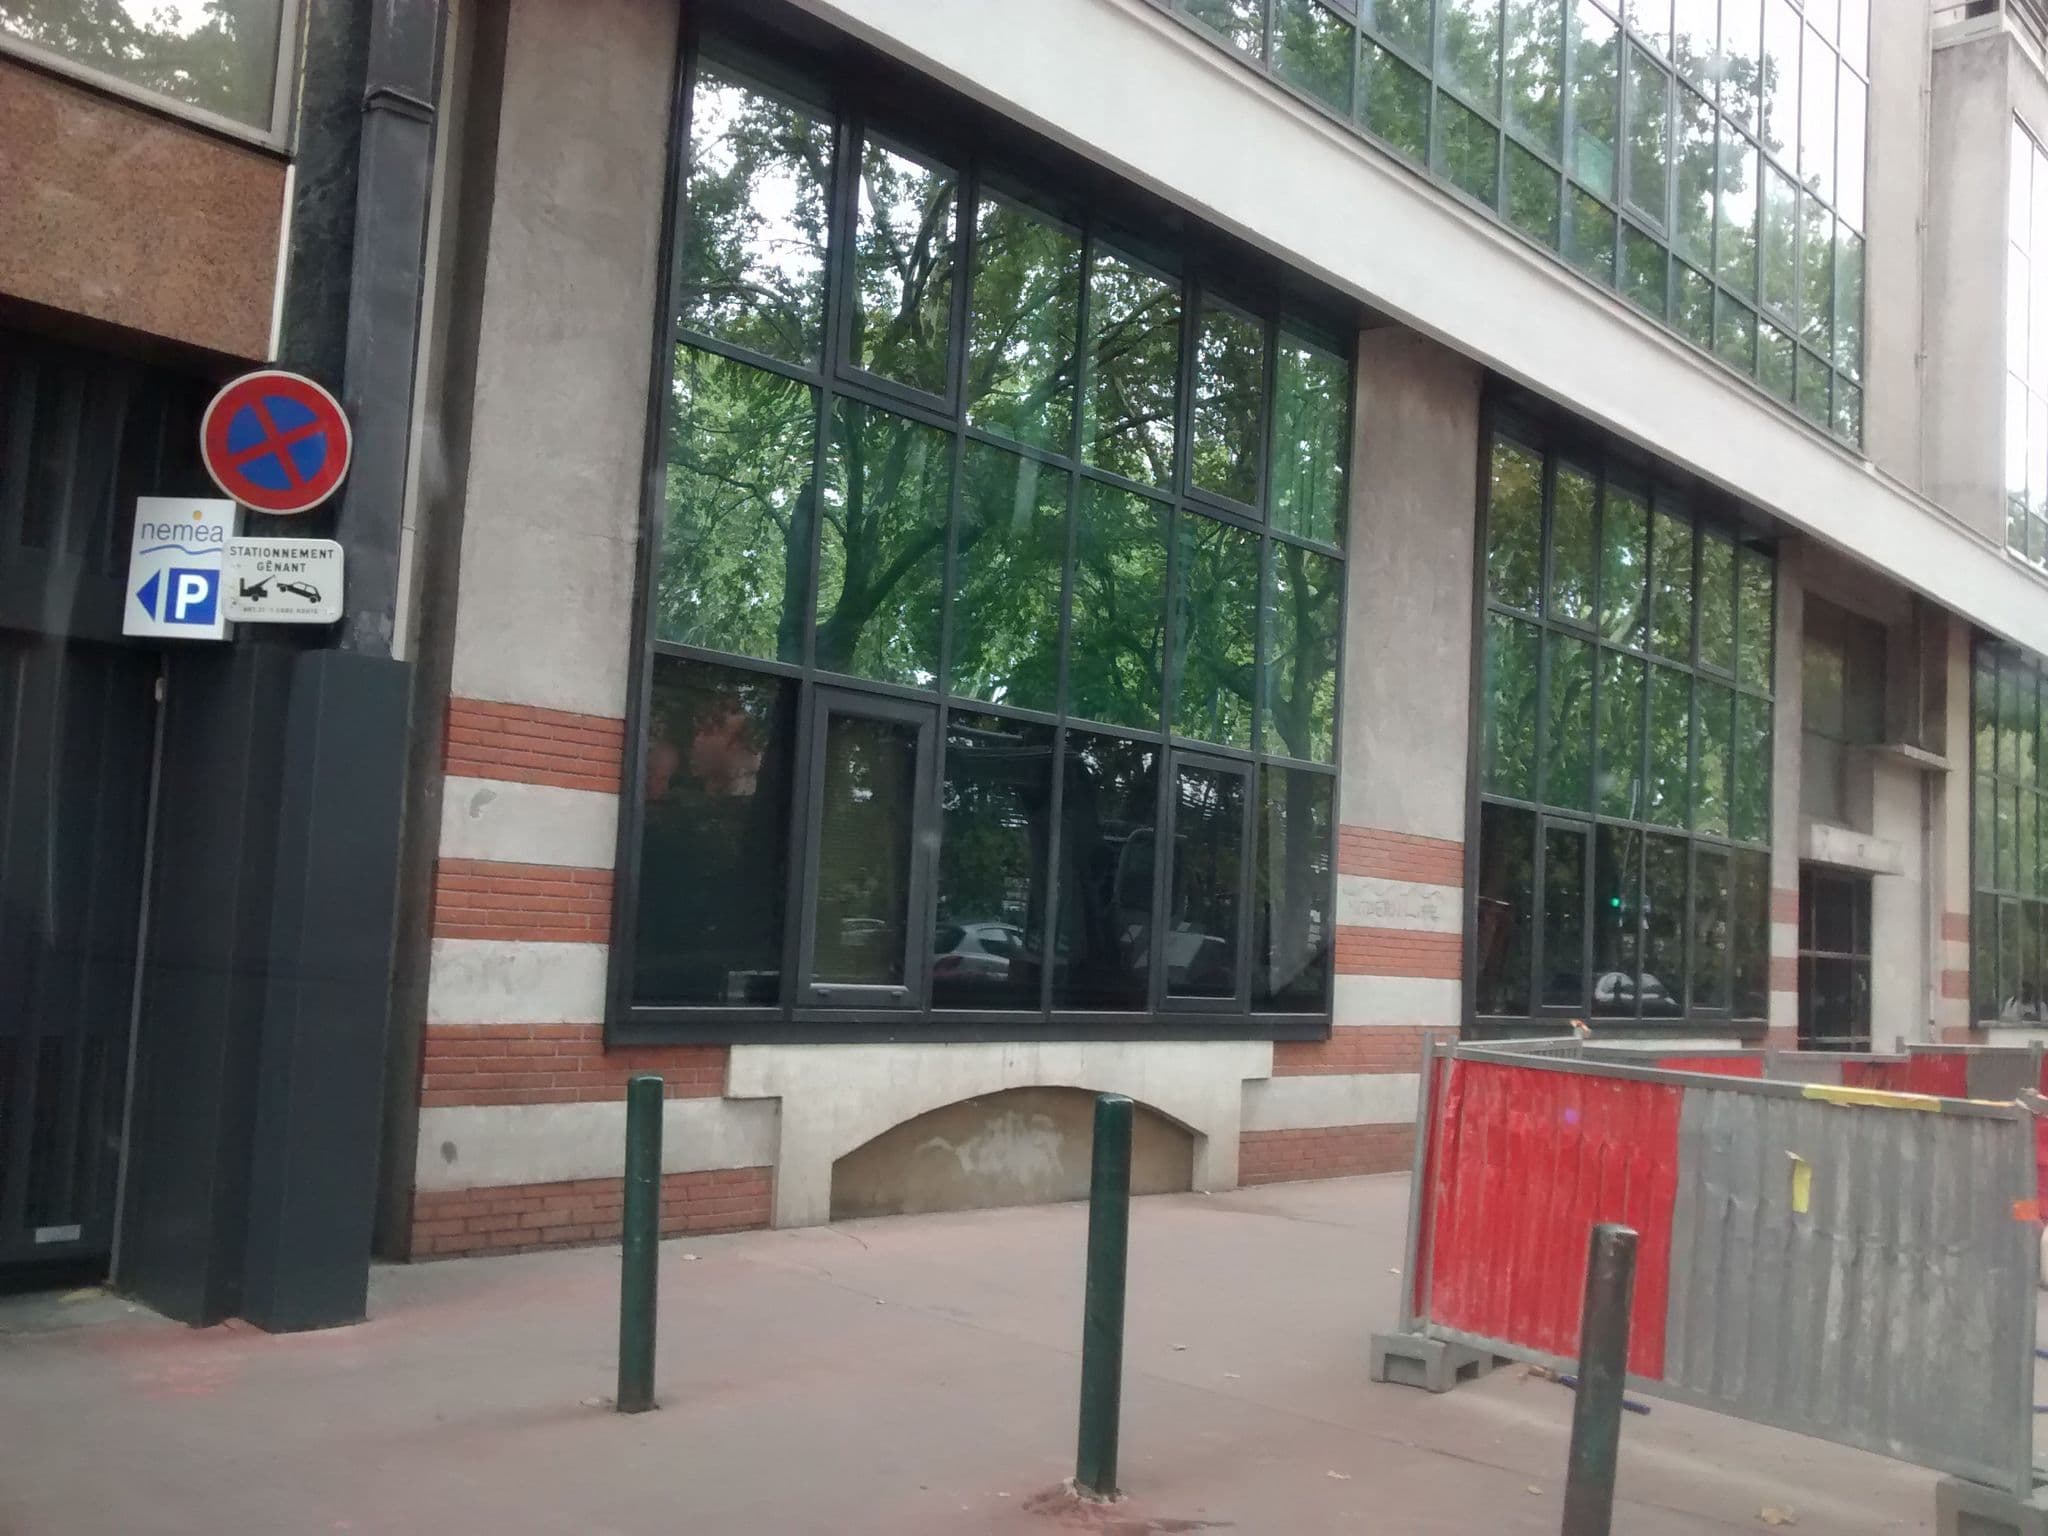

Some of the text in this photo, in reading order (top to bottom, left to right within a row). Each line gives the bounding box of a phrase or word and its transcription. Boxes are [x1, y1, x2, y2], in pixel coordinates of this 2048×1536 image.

[229, 546, 334, 560] STATIONNEMENT
[256, 560, 307, 573] GÊNANT
[174, 573, 209, 620] P
